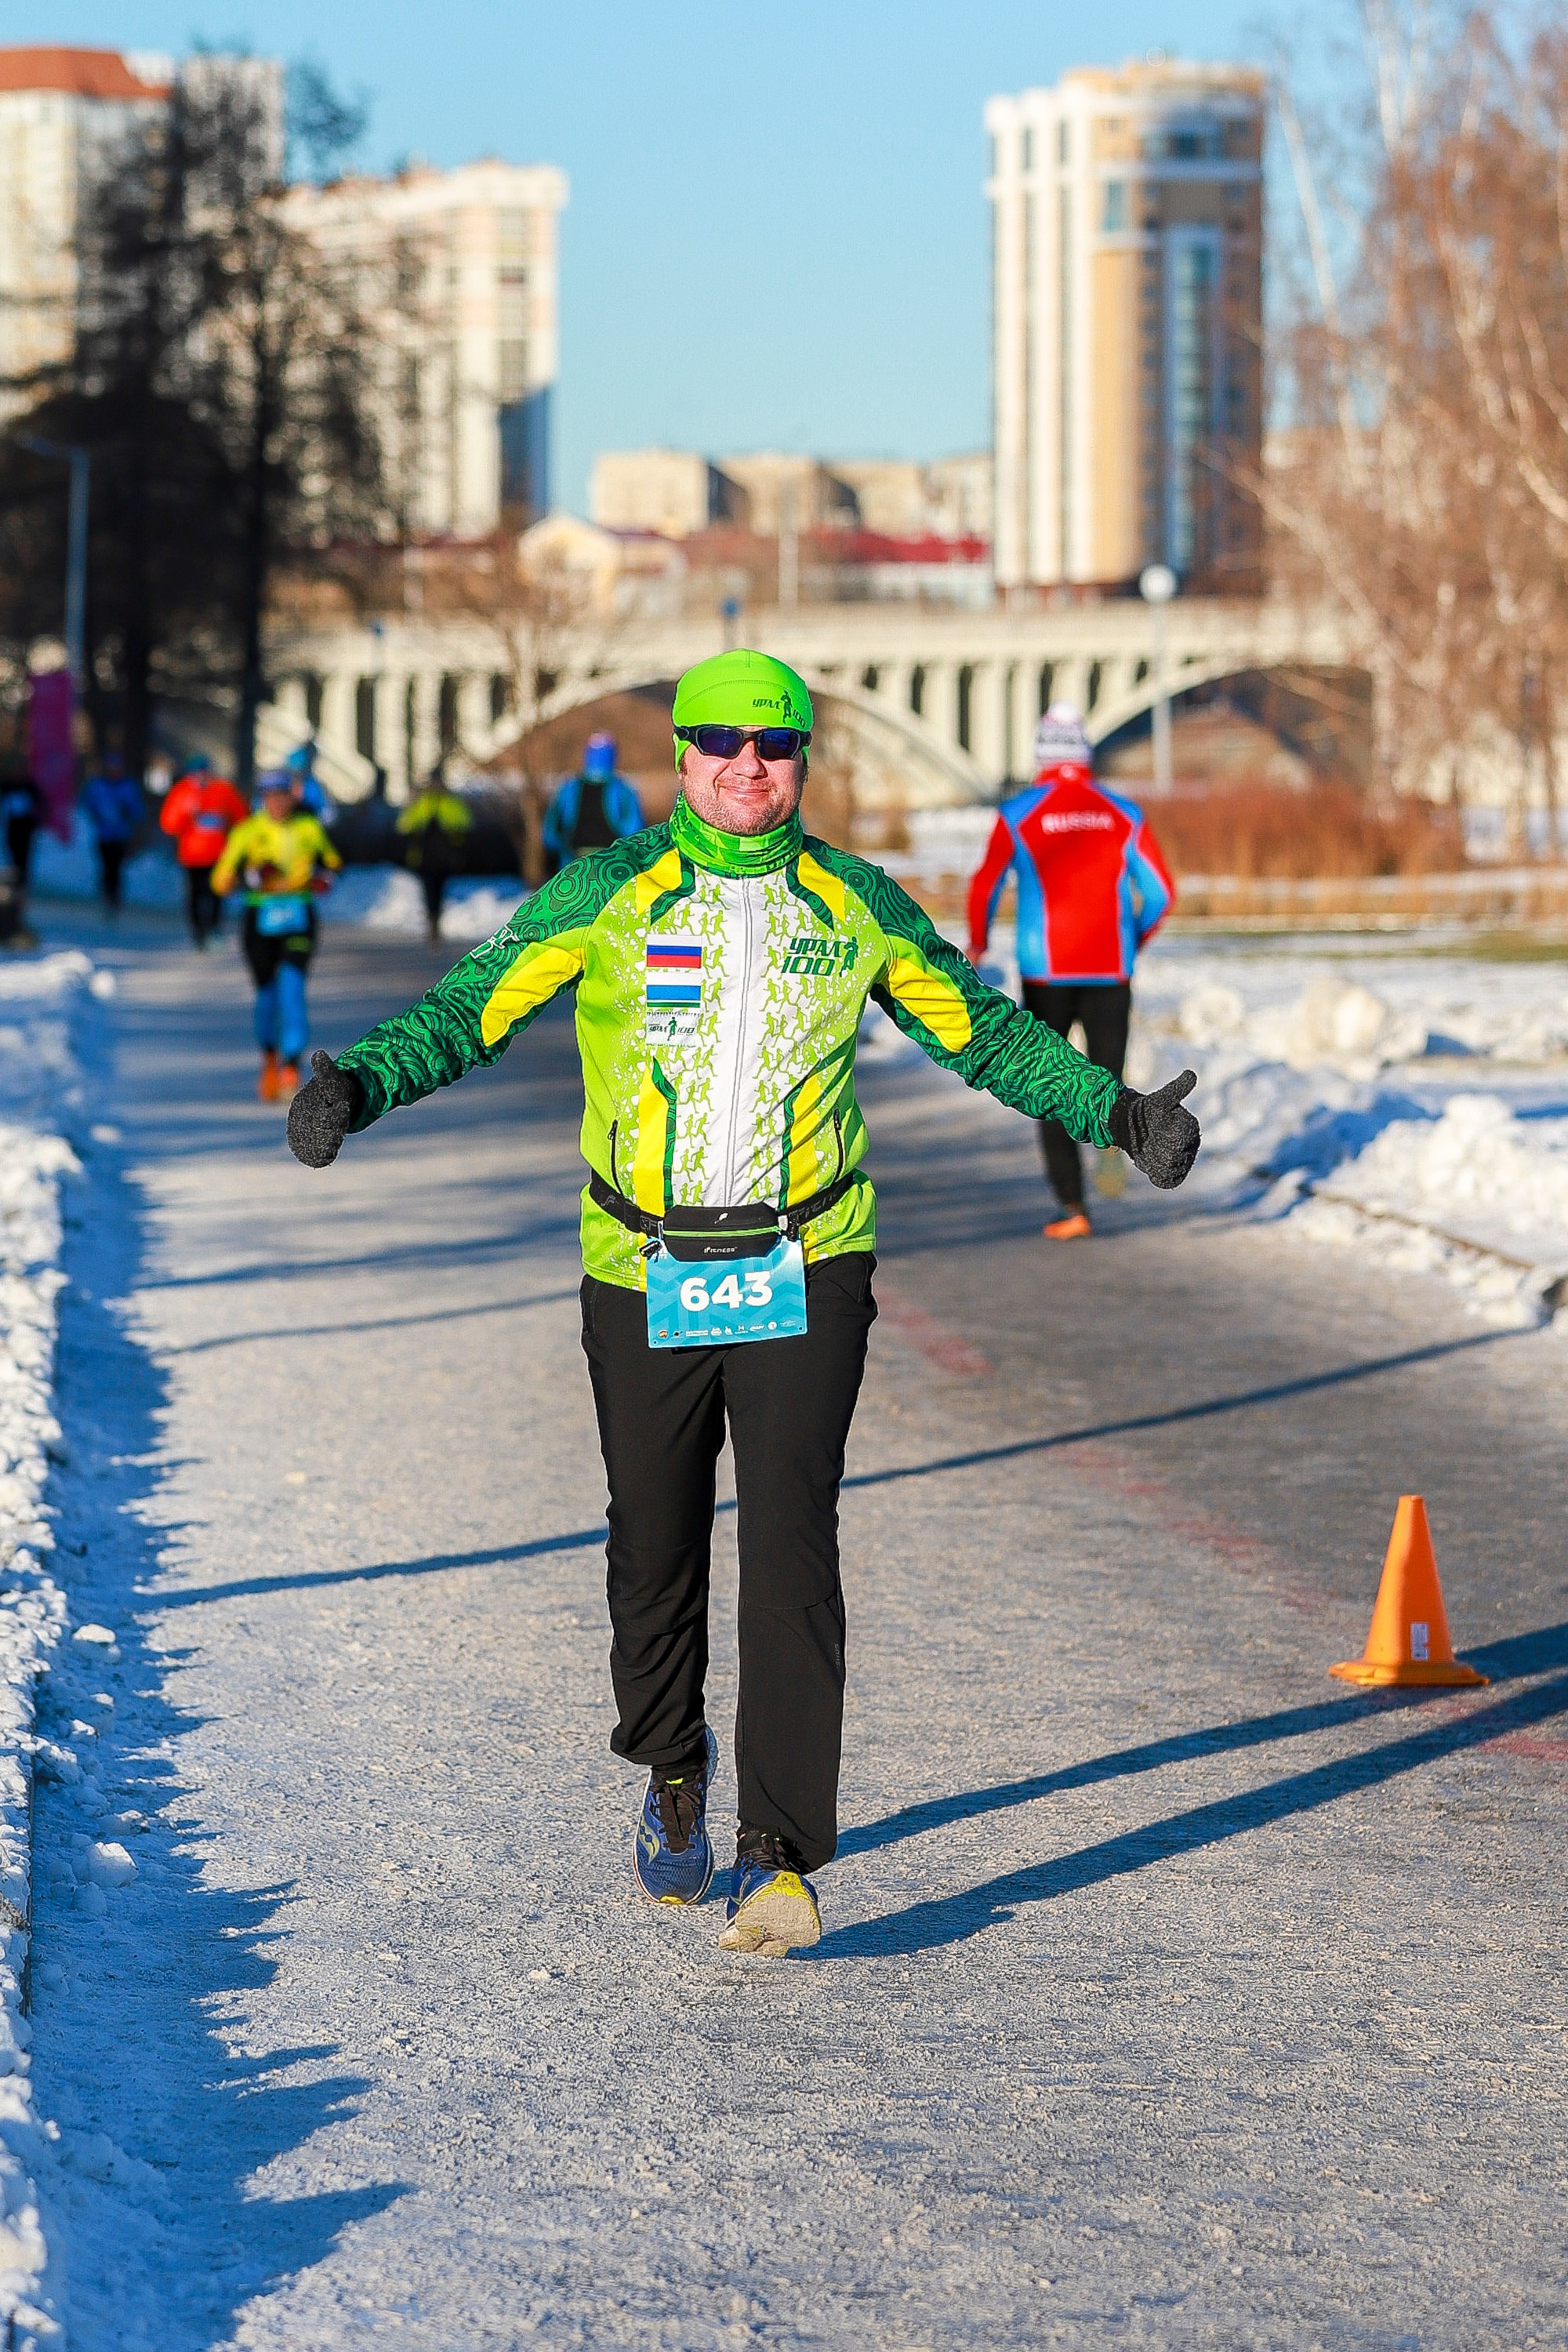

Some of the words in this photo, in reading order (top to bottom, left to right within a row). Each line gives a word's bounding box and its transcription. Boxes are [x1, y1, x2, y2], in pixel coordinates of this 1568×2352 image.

[752, 699, 782, 710] УРАЛ
[793, 710, 806, 728] 100
[788, 938, 846, 958] УРАЛ
[781, 956, 836, 976] 100
[680, 1270, 773, 1312] 643
